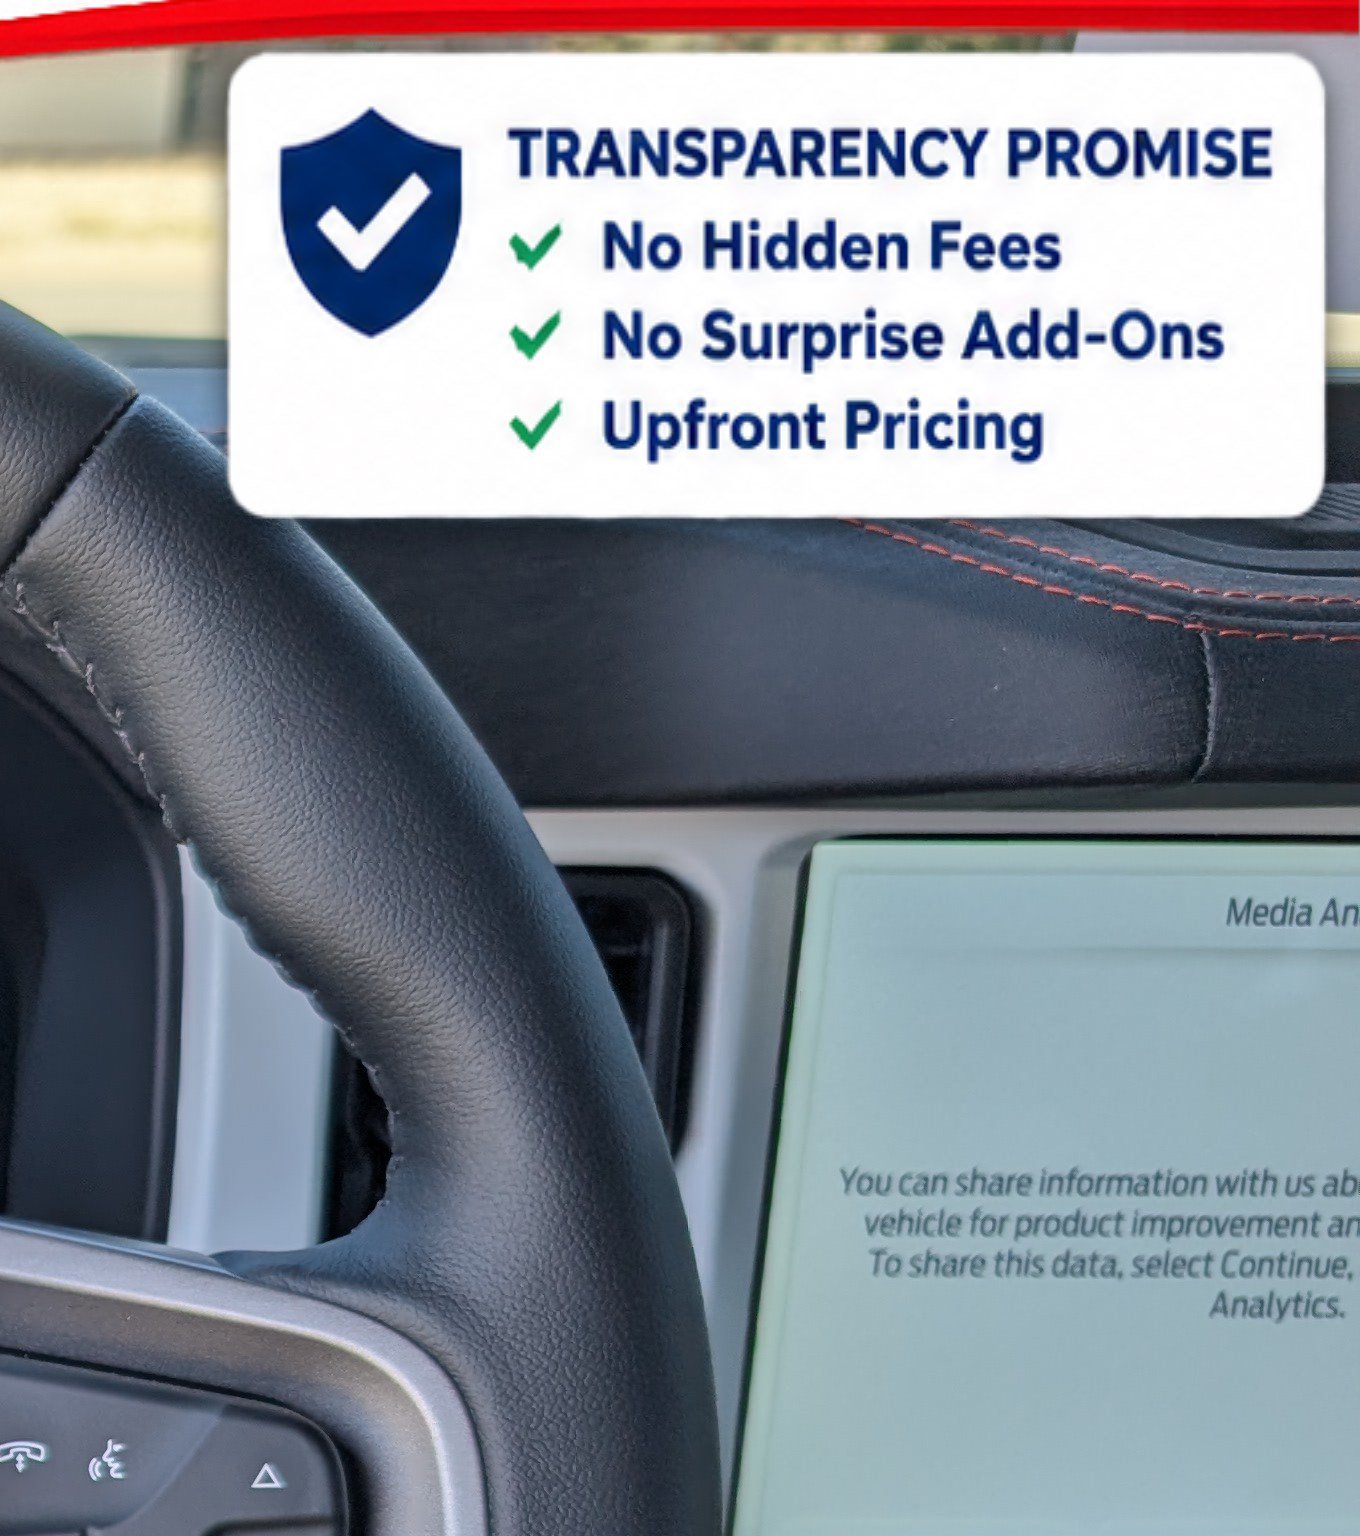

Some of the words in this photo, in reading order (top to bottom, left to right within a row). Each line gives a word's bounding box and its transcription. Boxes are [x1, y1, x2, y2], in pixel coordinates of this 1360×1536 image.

[1226, 897, 1313, 927] Media
[839, 1166, 893, 1198] You
[898, 1171, 949, 1198] can
[953, 1166, 1034, 1198] share
[1038, 1166, 1209, 1198] information
[1215, 1167, 1279, 1198] with
[1284, 1174, 1316, 1198] us
[864, 1206, 963, 1239] vehicle
[968, 1206, 1010, 1239] for
[1013, 1208, 1126, 1243] product
[1130, 1209, 1323, 1242] improvement
[868, 1248, 904, 1280] To
[906, 1248, 987, 1280] share
[993, 1249, 1047, 1280] this
[1050, 1250, 1125, 1281] data,
[1129, 1250, 1216, 1280] select
[1220, 1248, 1355, 1283] Continue,
[1208, 1290, 1347, 1325] Analytics.
